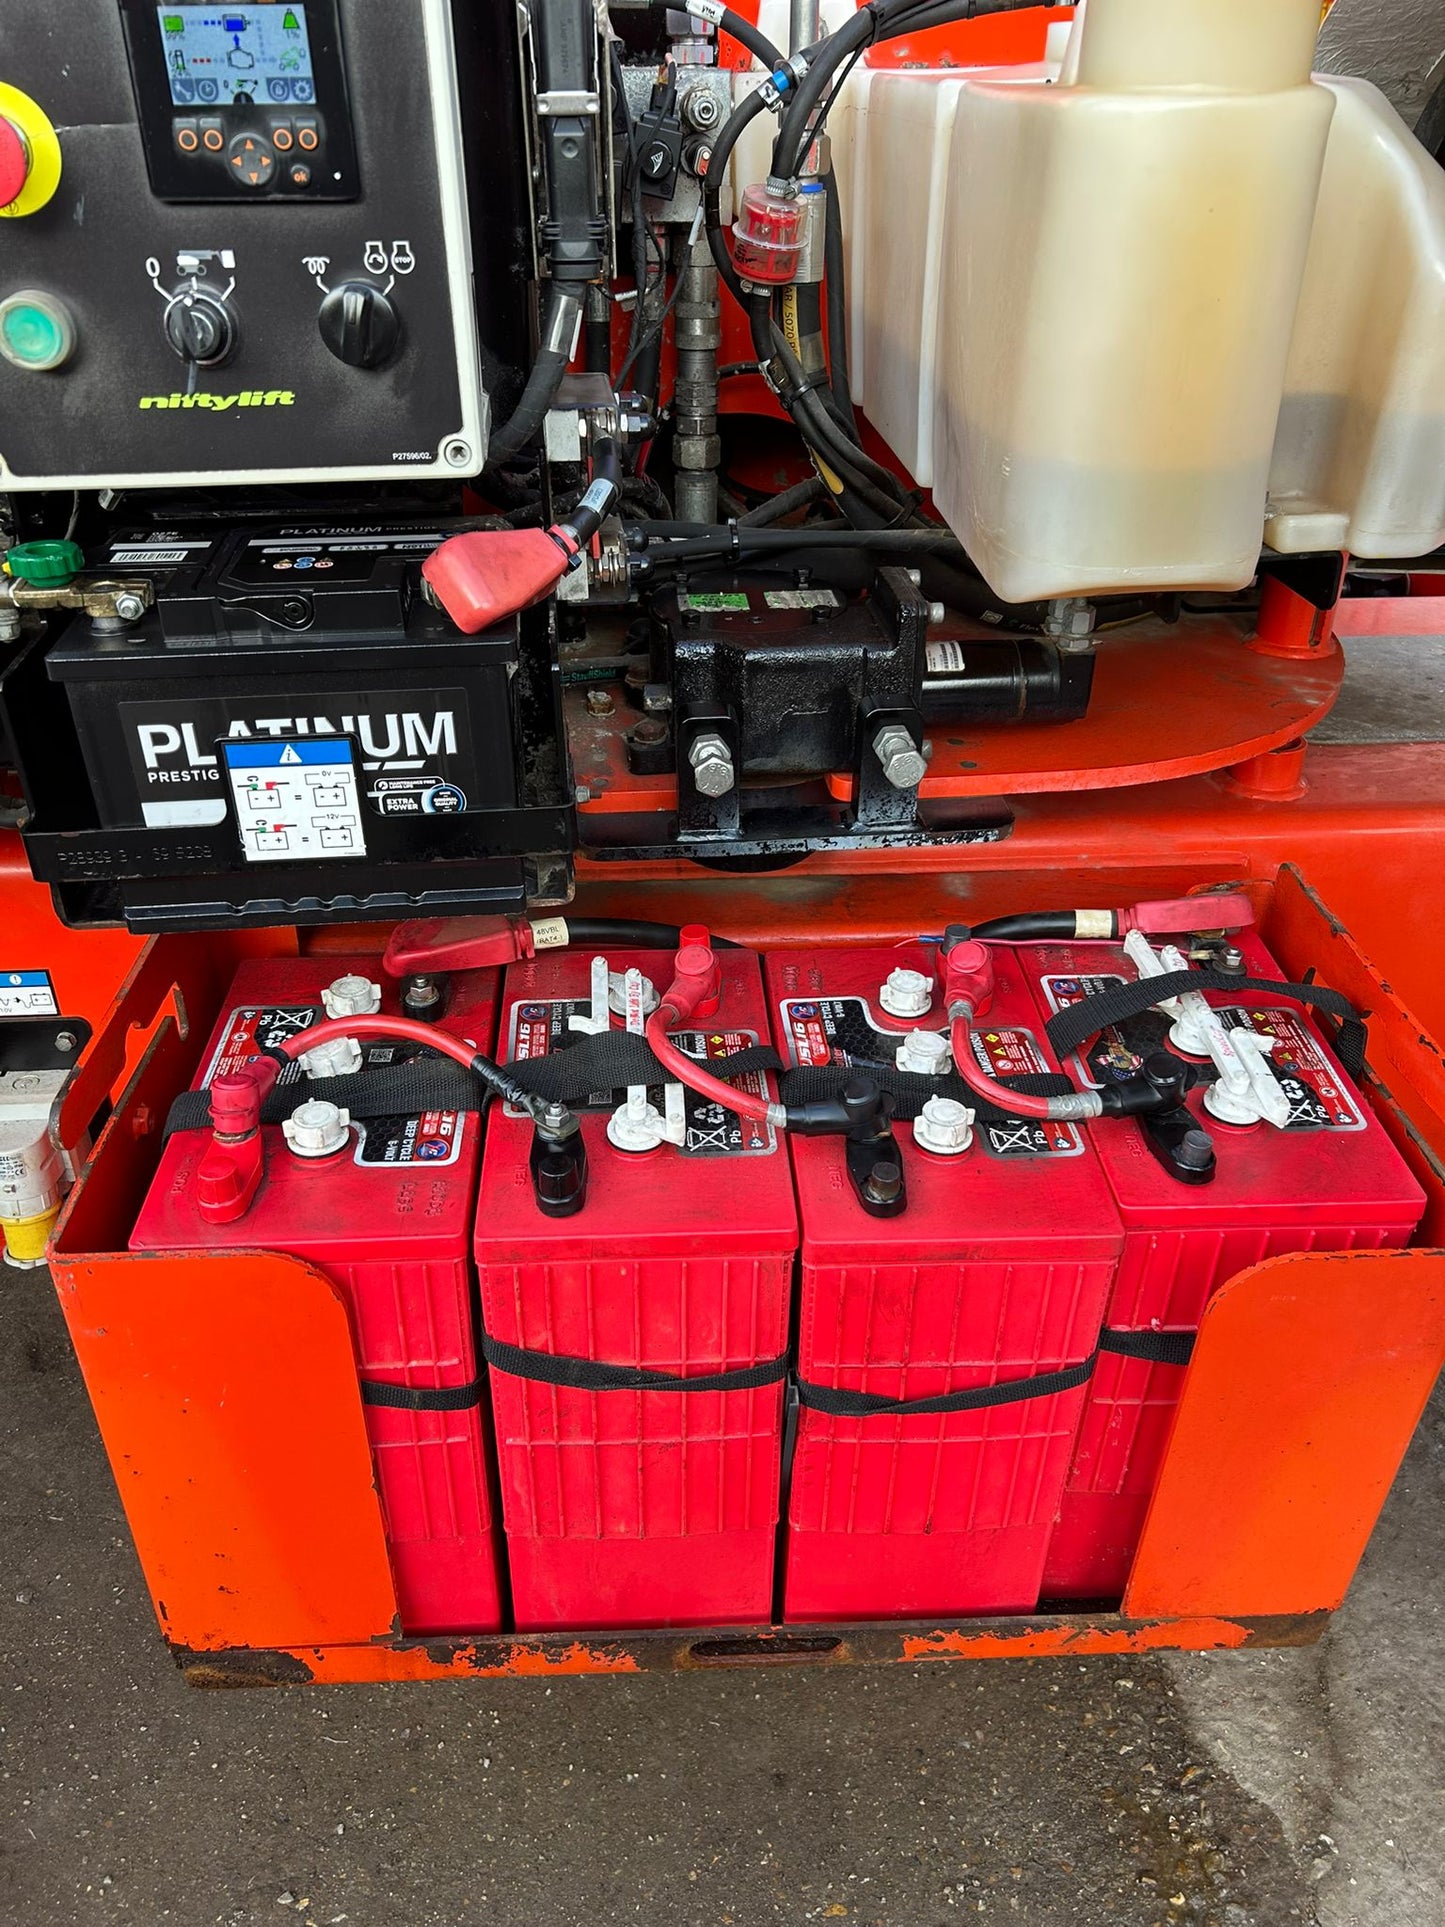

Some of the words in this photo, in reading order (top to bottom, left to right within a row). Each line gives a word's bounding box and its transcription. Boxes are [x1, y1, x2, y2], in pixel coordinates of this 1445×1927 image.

[394, 256, 412, 264] STOP
[784, 287, 793, 302] AR
[139, 390, 295, 411] niftylift
[279, 526, 382, 535] PLATINUM
[147, 768, 220, 784] PRESTIG
[386, 797, 415, 805] EXTRA
[387, 803, 419, 811] POWER
[820, 1001, 833, 1019] CYCLE
[259, 1014, 273, 1026] Pb
[824, 1019, 837, 1035] DEEP
[1314, 1104, 1330, 1119] Pb
[404, 1119, 419, 1138] DEEP
[729, 1129, 743, 1144] Pb
[1032, 1130, 1048, 1144] Pb
[399, 1138, 415, 1161] CYCLE
